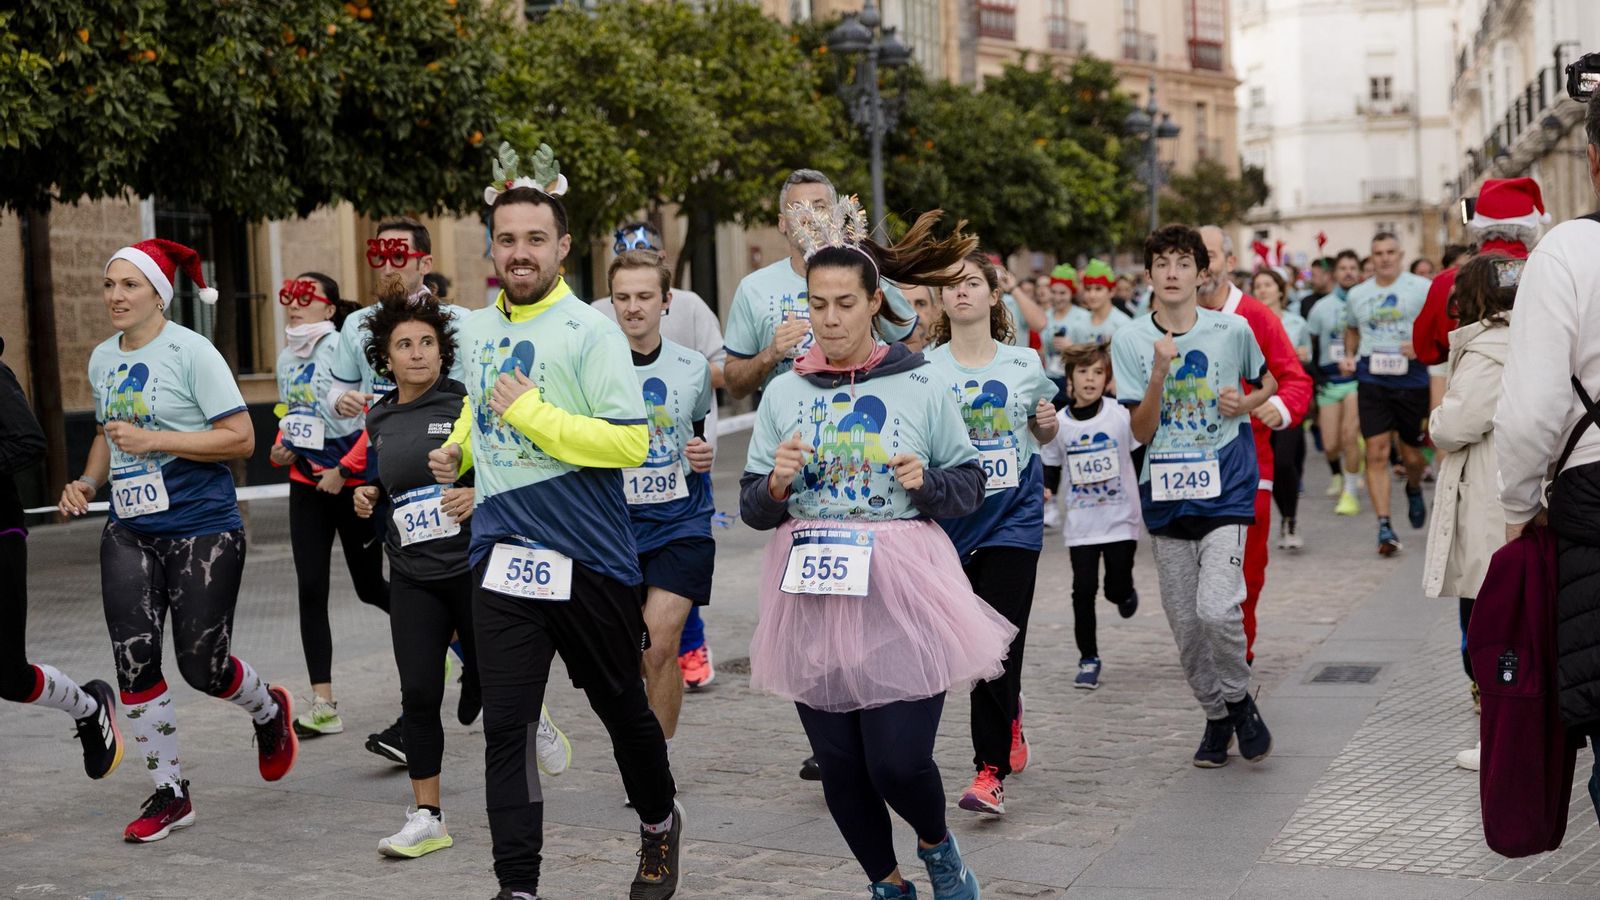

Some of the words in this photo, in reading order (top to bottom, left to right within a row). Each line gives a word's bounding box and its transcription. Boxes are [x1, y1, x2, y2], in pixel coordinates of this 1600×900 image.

[982, 459, 1008, 477] 50
[1075, 456, 1112, 475] 1463
[629, 472, 677, 494] 1298
[1160, 470, 1210, 489] 1249
[116, 483, 157, 507] 1270
[404, 507, 441, 532] 341
[506, 557, 551, 585] 556
[801, 556, 849, 580] 555
